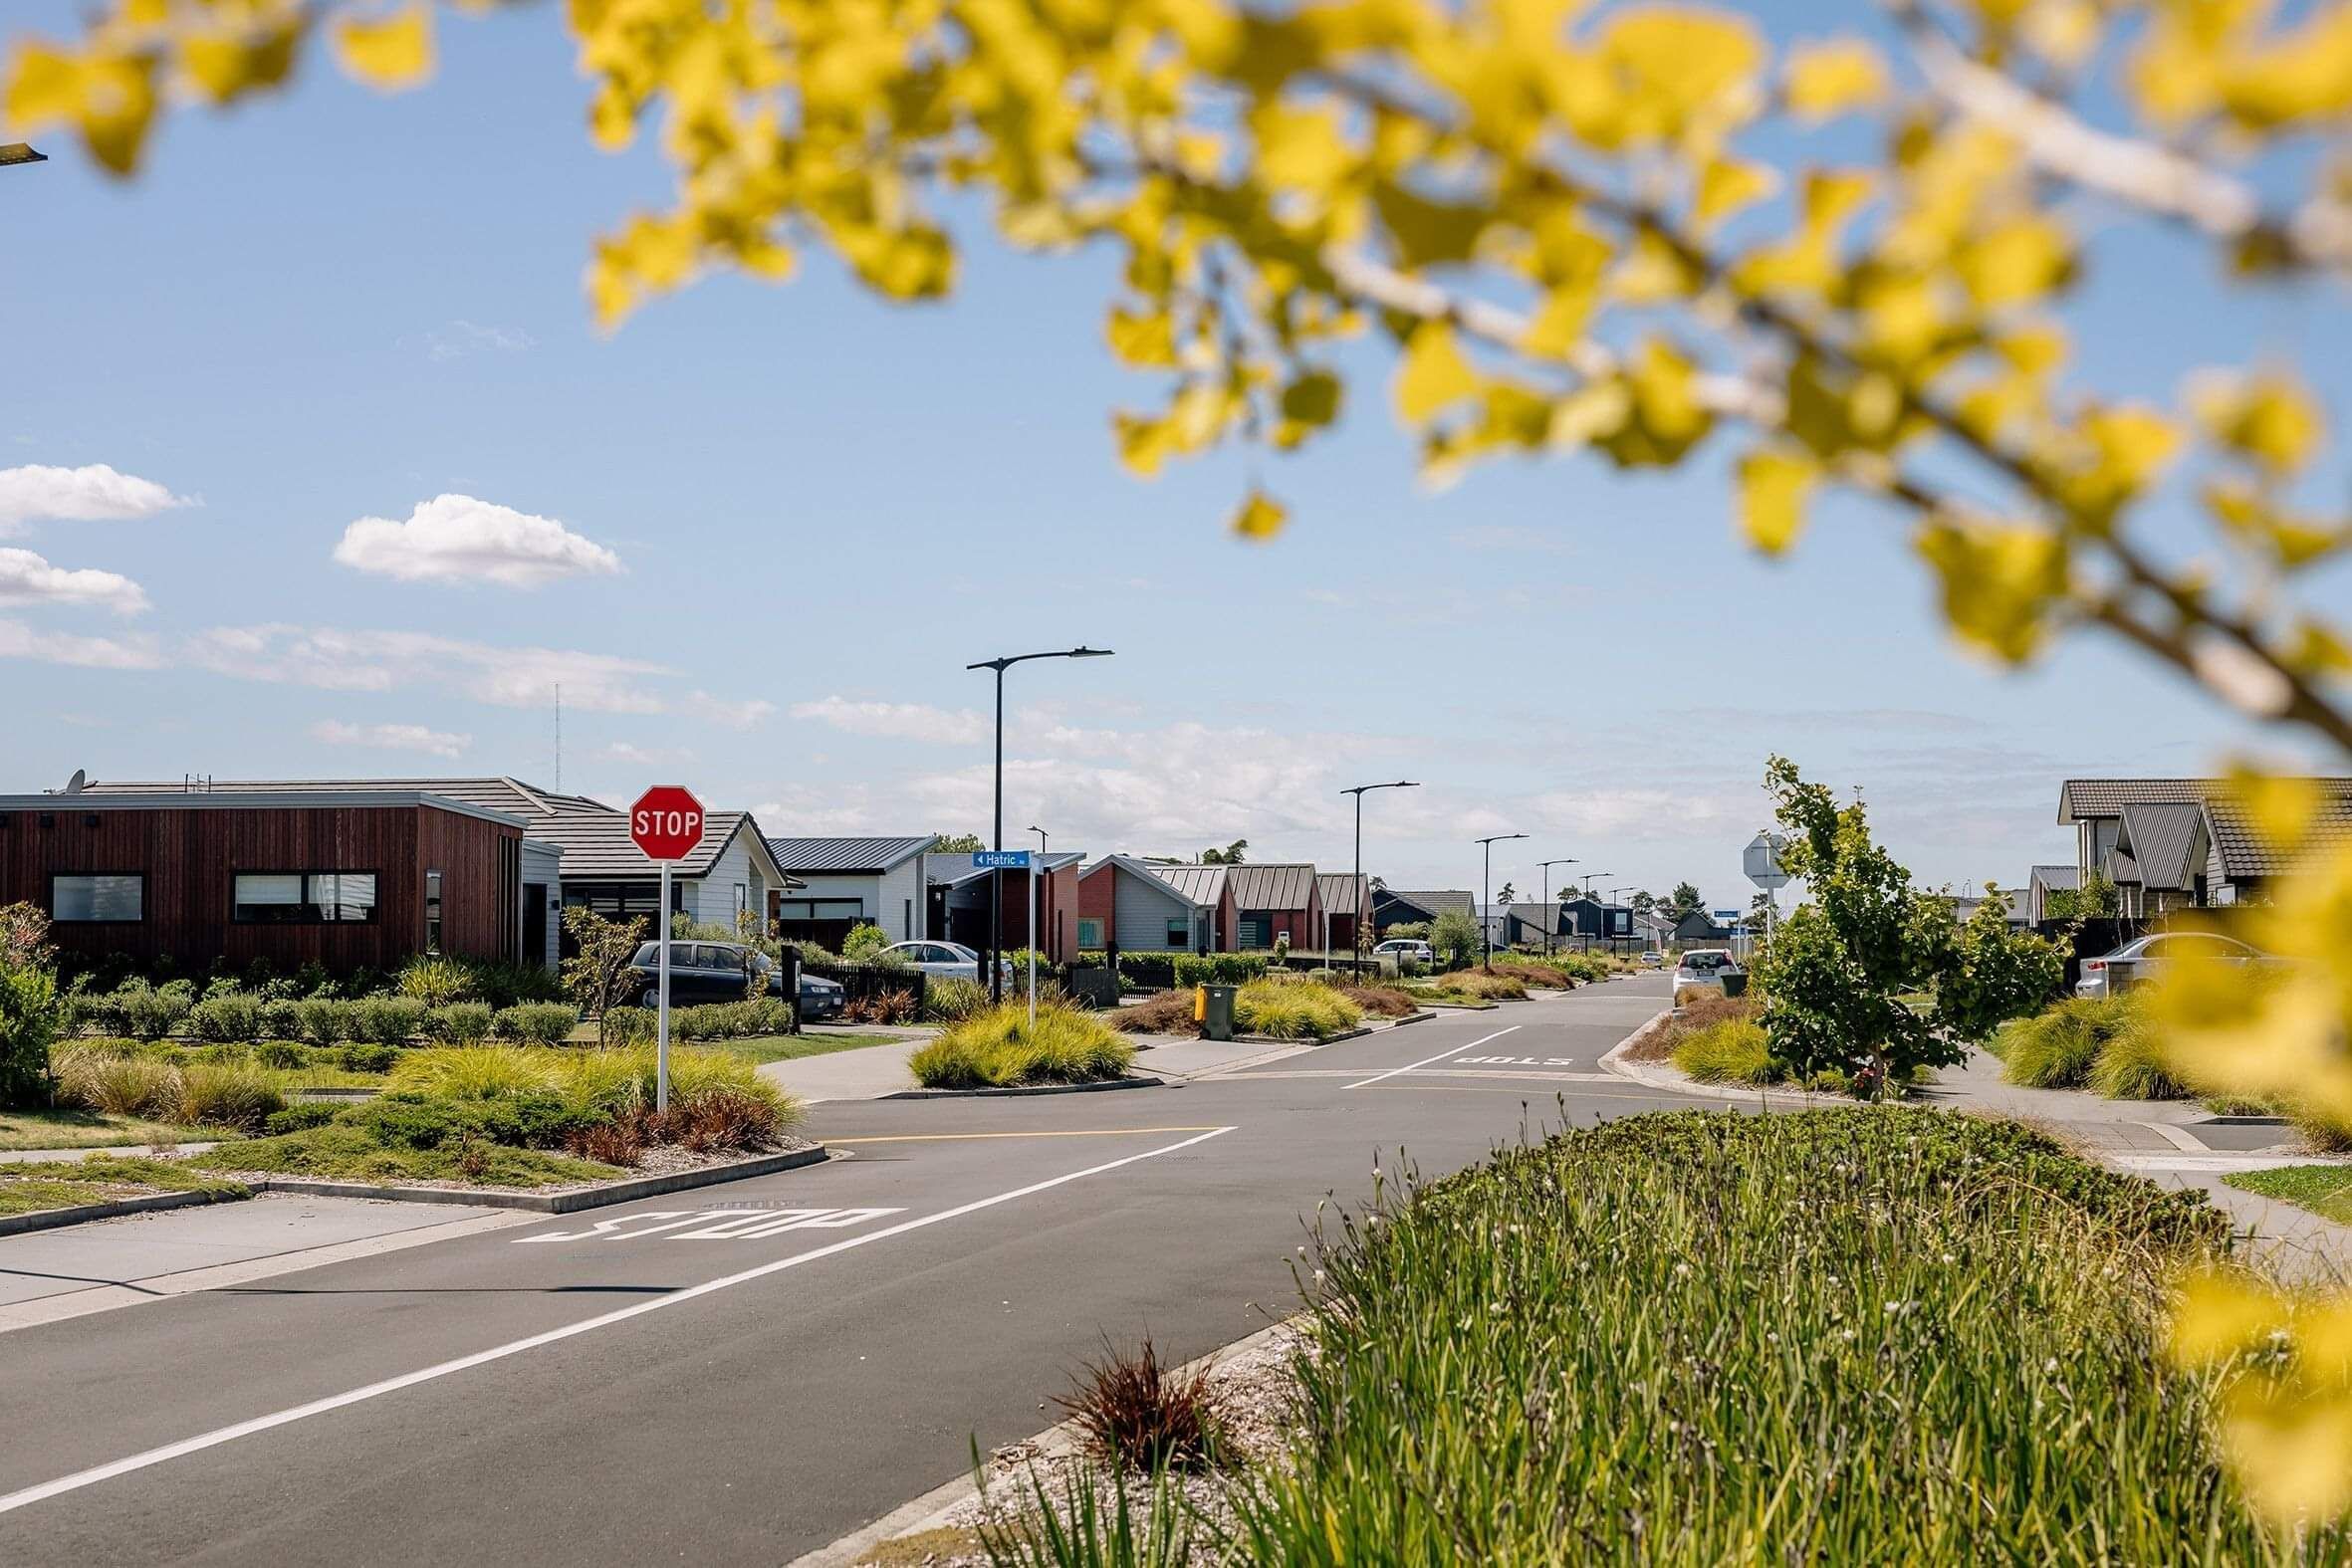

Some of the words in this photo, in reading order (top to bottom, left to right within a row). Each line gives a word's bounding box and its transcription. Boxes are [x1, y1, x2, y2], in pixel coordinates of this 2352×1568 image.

[635, 810, 699, 836] STOP
[986, 854, 1016, 865] Hatric
[1454, 1056, 1573, 1066] STOP
